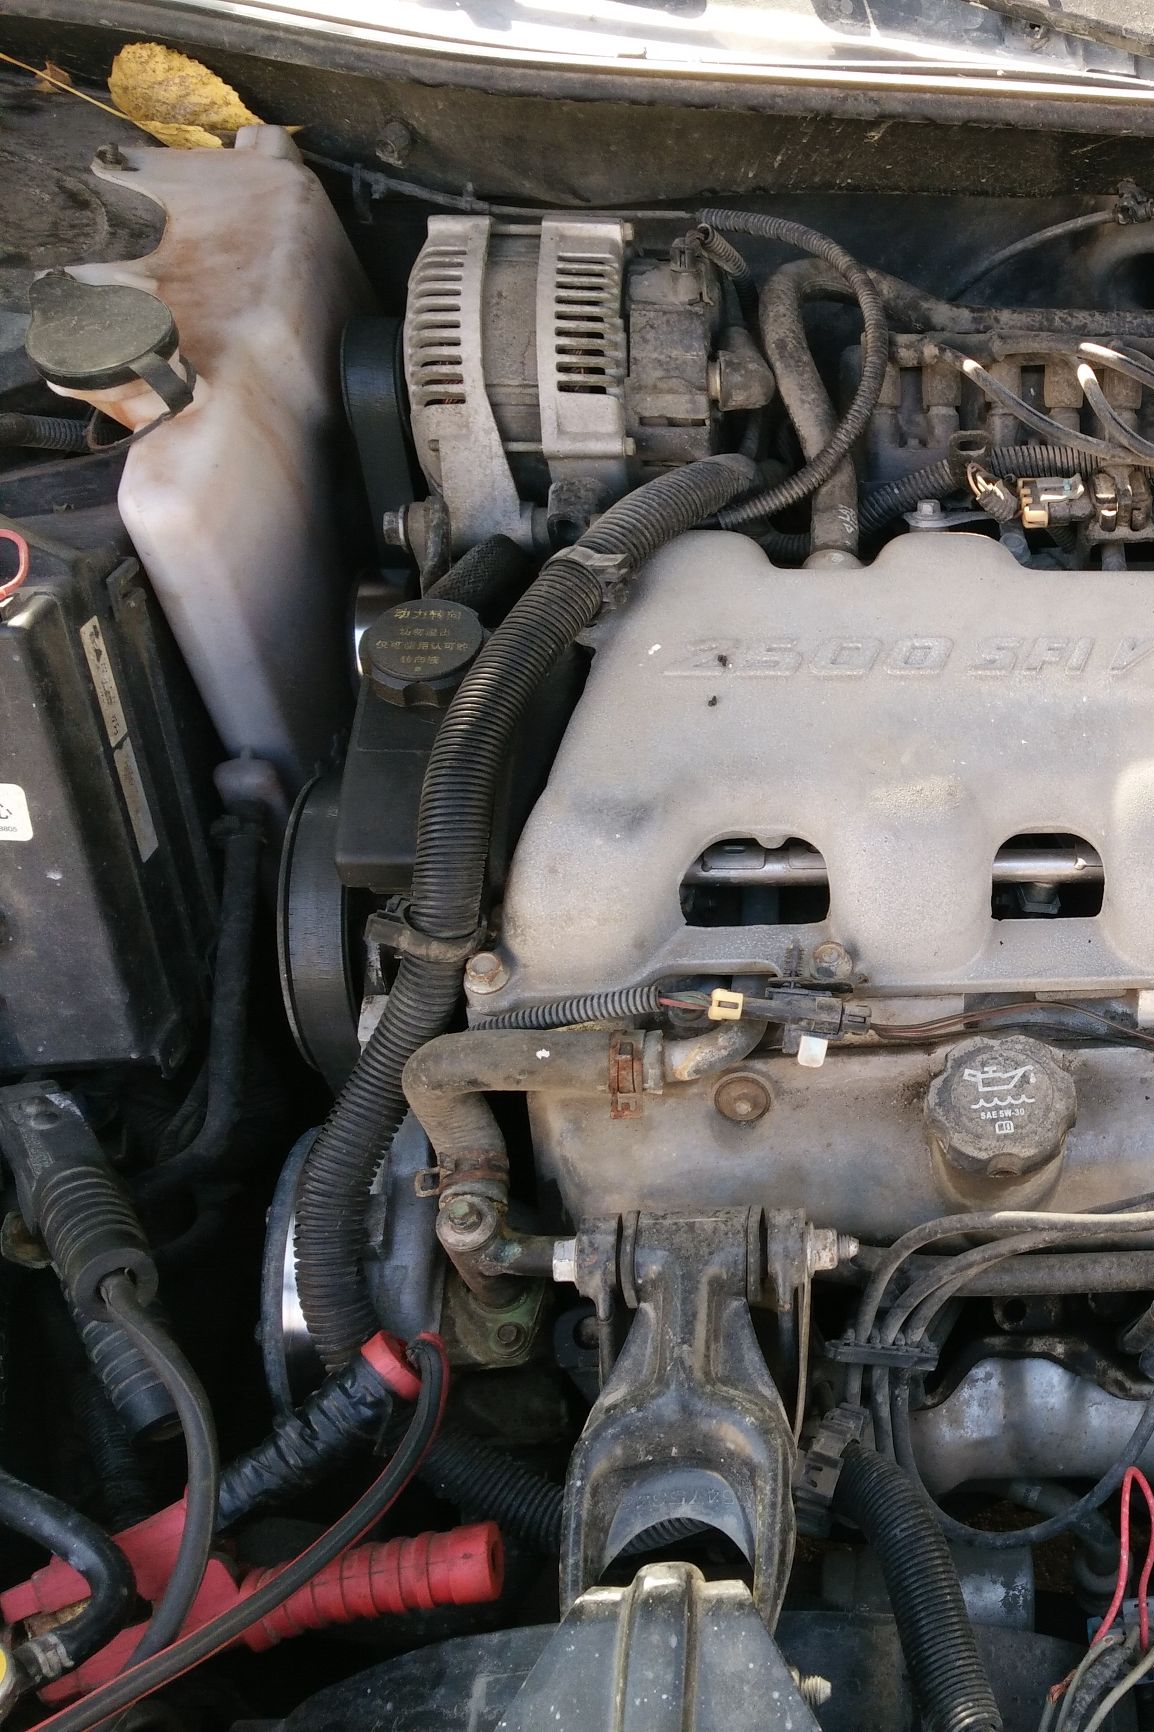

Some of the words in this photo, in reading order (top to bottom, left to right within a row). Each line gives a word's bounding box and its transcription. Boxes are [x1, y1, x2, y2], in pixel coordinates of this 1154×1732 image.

[967, 635, 1096, 675] SFI
[980, 1110, 998, 1120] SAE
[999, 1107, 1025, 1118] 5W-30
